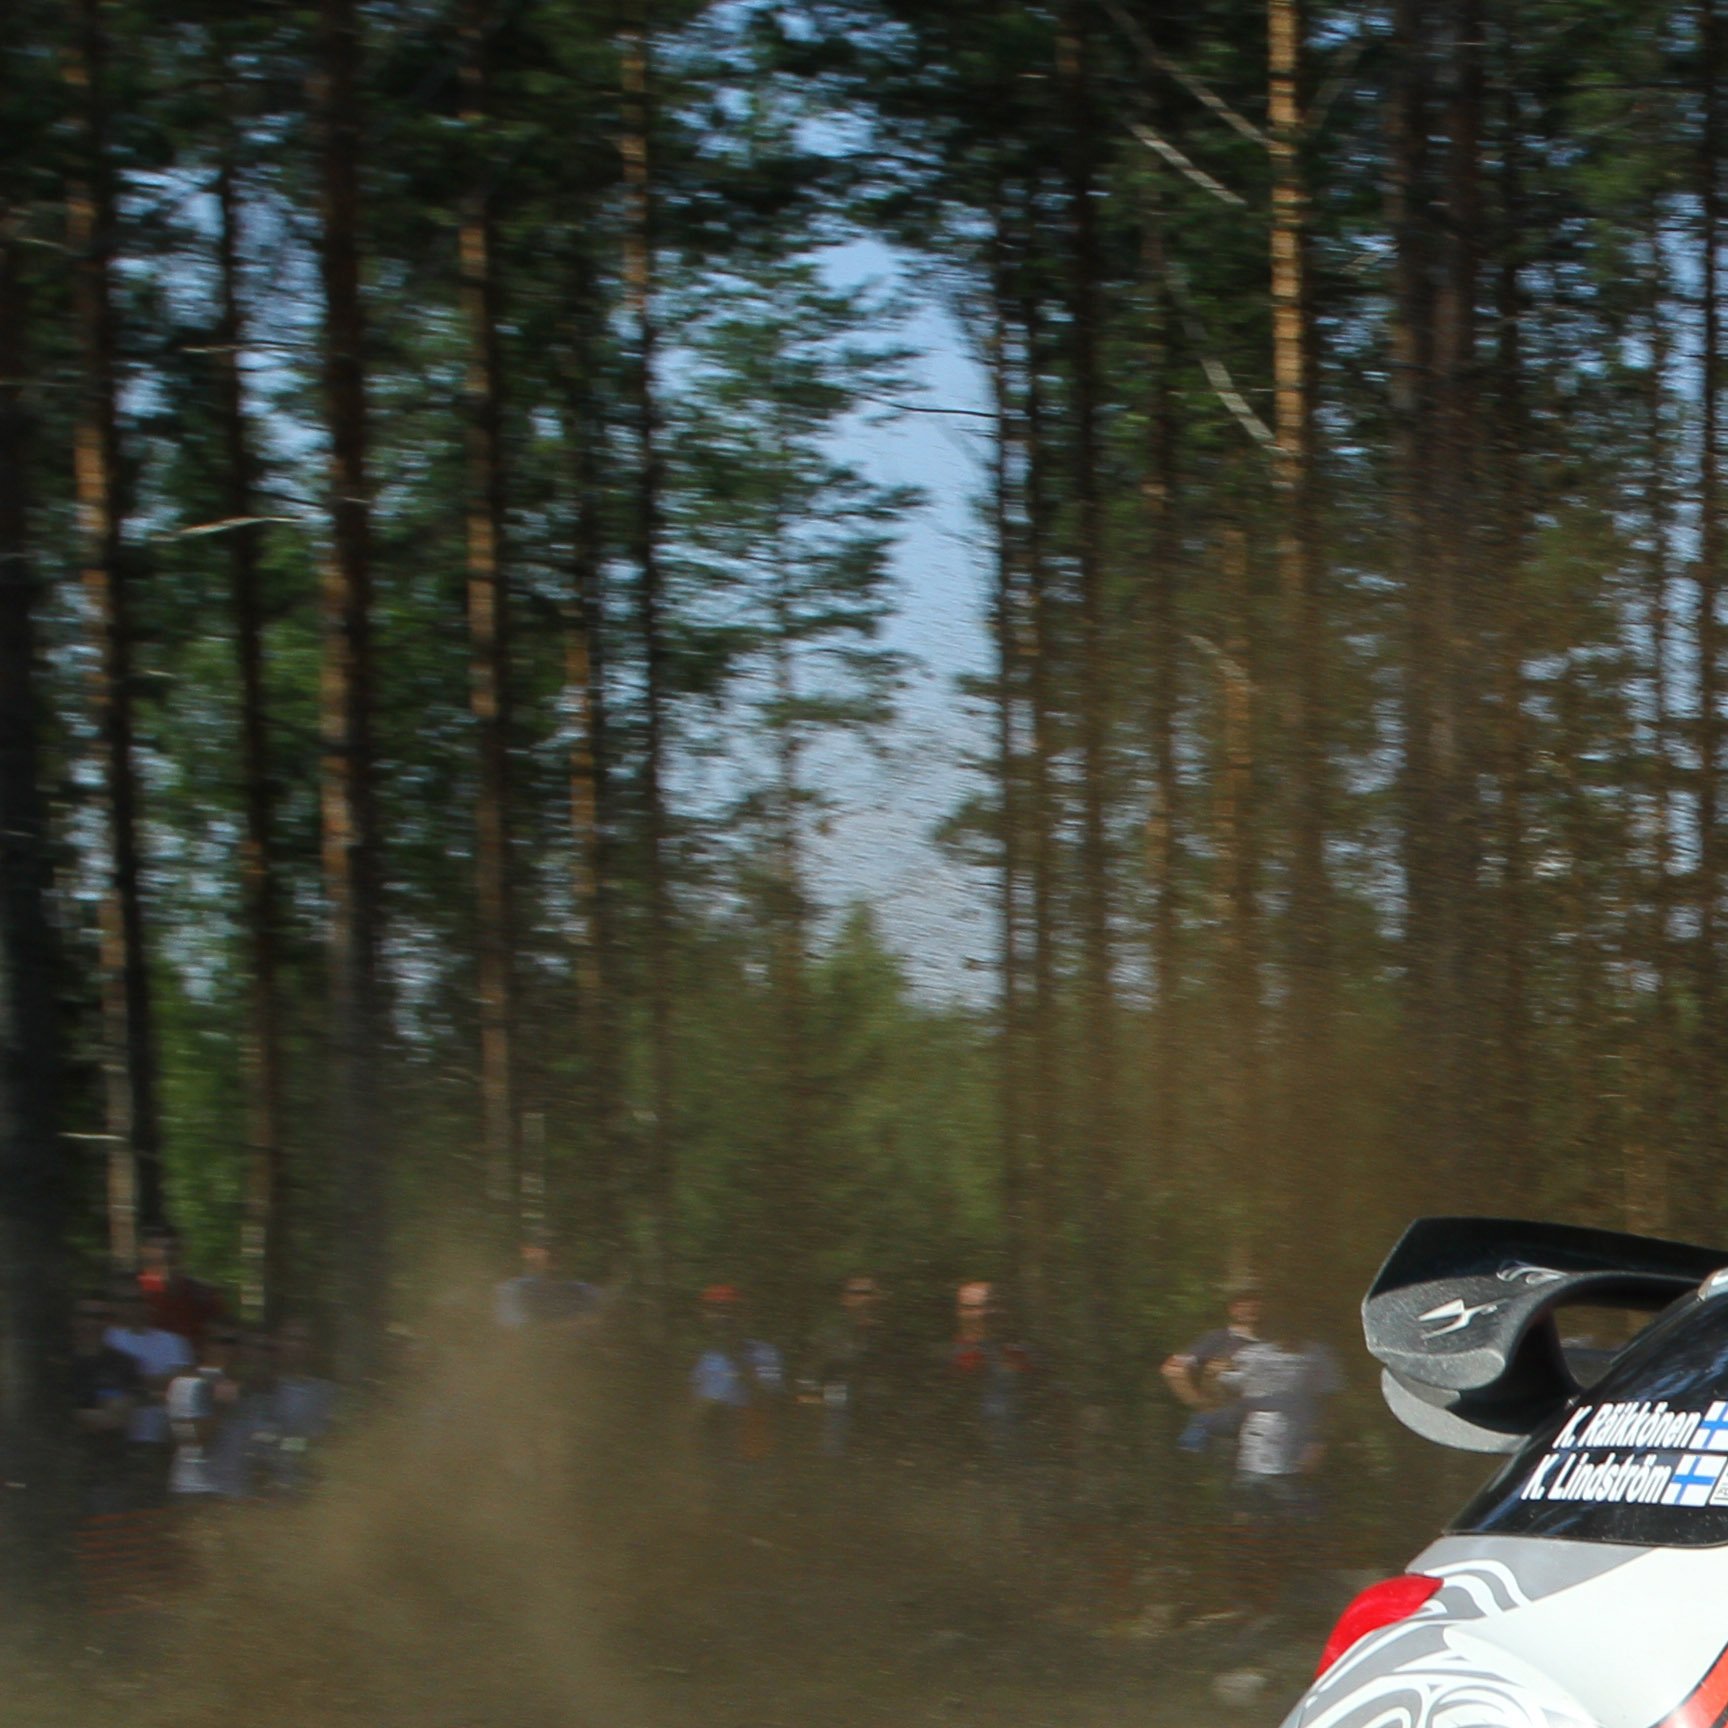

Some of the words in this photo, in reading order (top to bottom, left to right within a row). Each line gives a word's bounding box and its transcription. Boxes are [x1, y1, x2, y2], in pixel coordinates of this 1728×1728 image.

[1552, 1405, 1593, 1450] K.
[1577, 1401, 1701, 1449] Räikkönen
[1520, 1453, 1560, 1500] K.
[1547, 1452, 1672, 1503] Lindström
